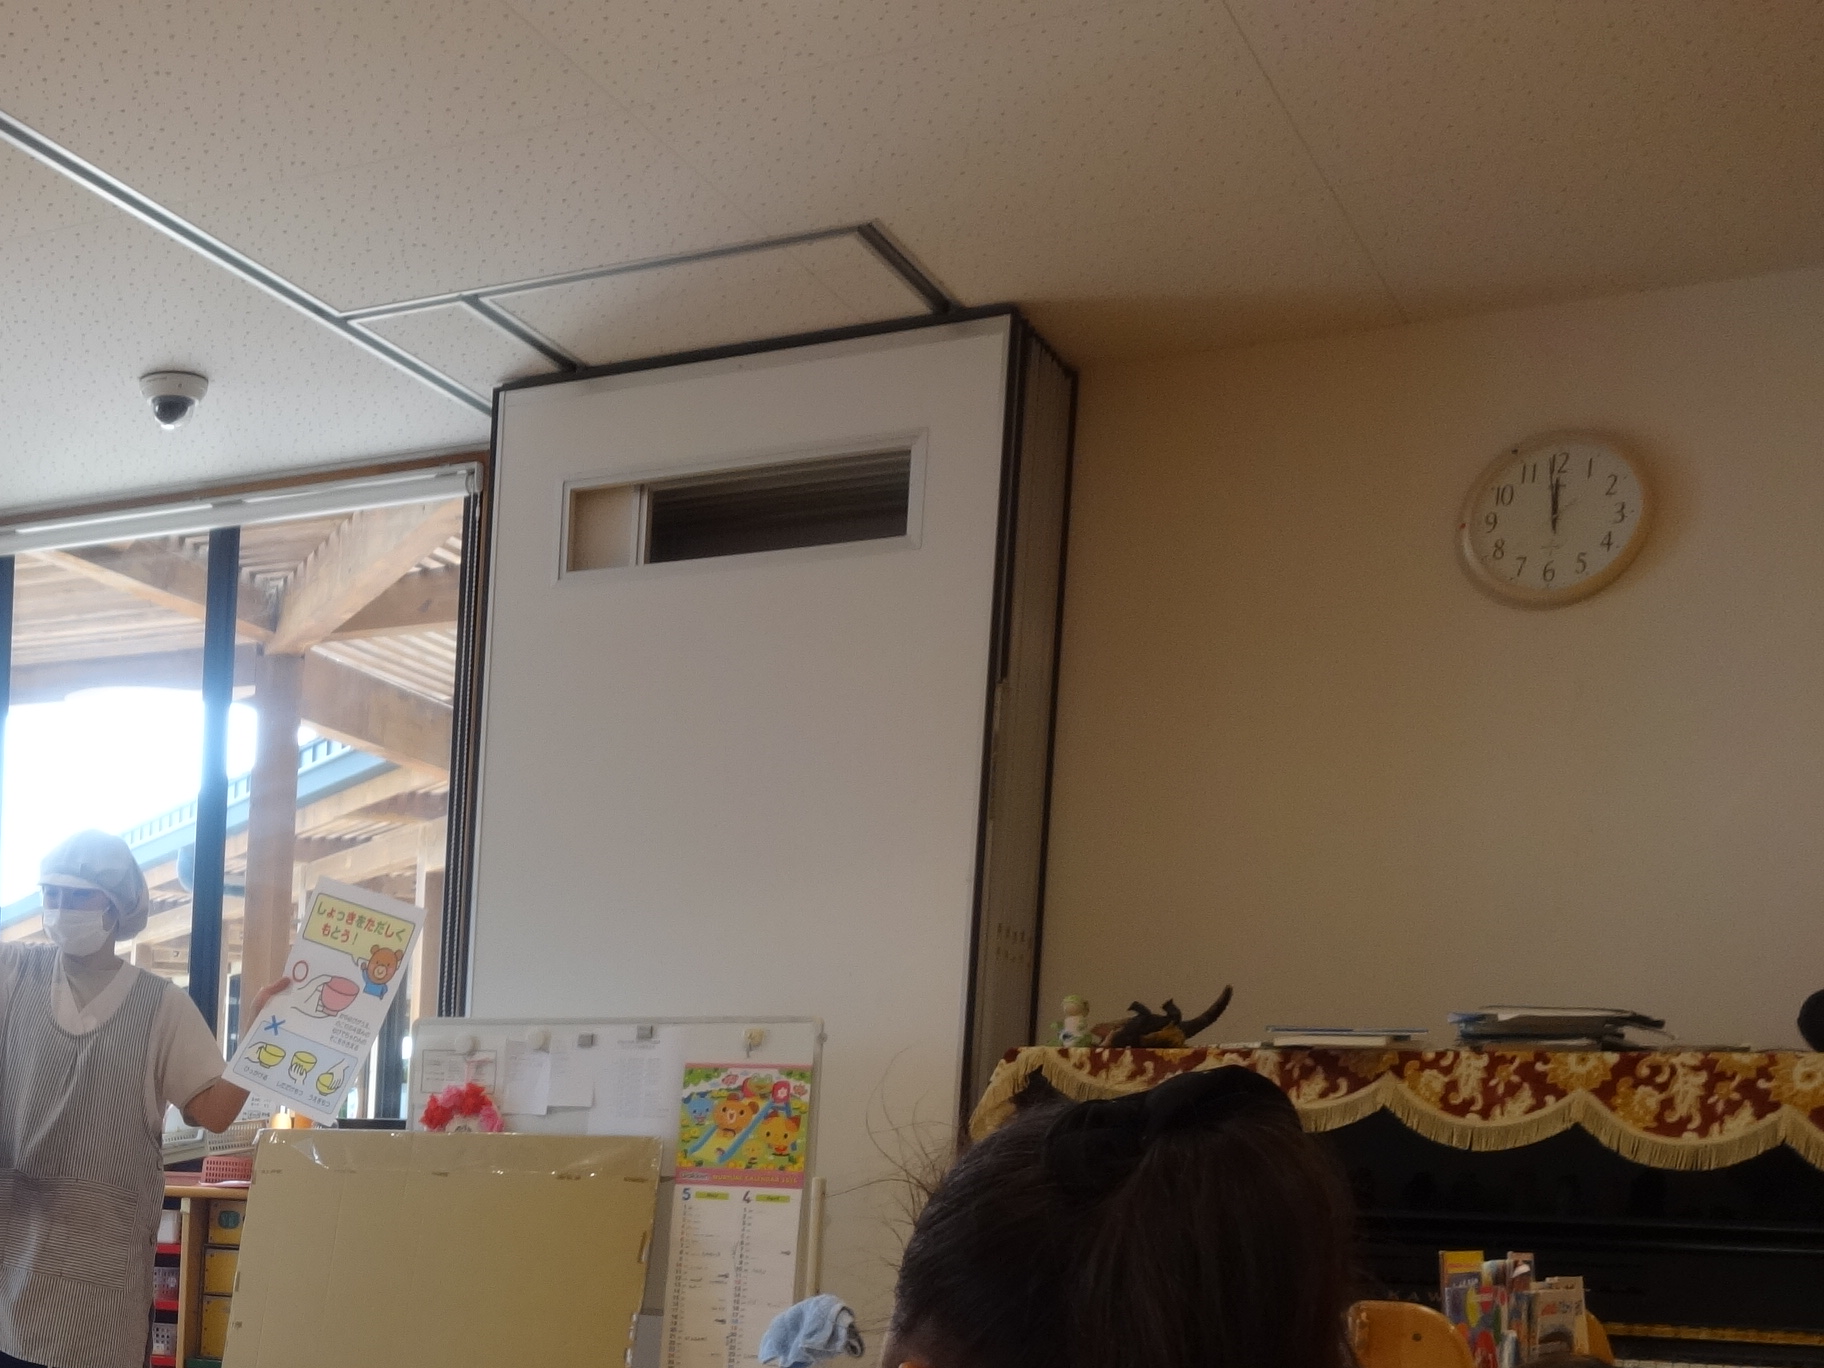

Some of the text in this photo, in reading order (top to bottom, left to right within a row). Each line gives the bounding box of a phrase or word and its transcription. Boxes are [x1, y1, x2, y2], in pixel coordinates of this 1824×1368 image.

[1521, 463, 1537, 484] 11
[1550, 452, 1570, 474] 12
[1587, 457, 1593, 479] 1
[1495, 484, 1514, 507] 10
[1605, 474, 1618, 496] 2
[1485, 512, 1498, 533] 9
[1613, 502, 1626, 524] 3
[1492, 538, 1505, 560] 8
[1600, 531, 1613, 552] 4
[1516, 556, 1527, 577] 7
[1543, 560, 1555, 582] 6
[1575, 552, 1587, 574] 5
[317, 901, 407, 942] しょっきをただしく
[682, 1187, 691, 1201] 5
[742, 1190, 751, 1204] 4
